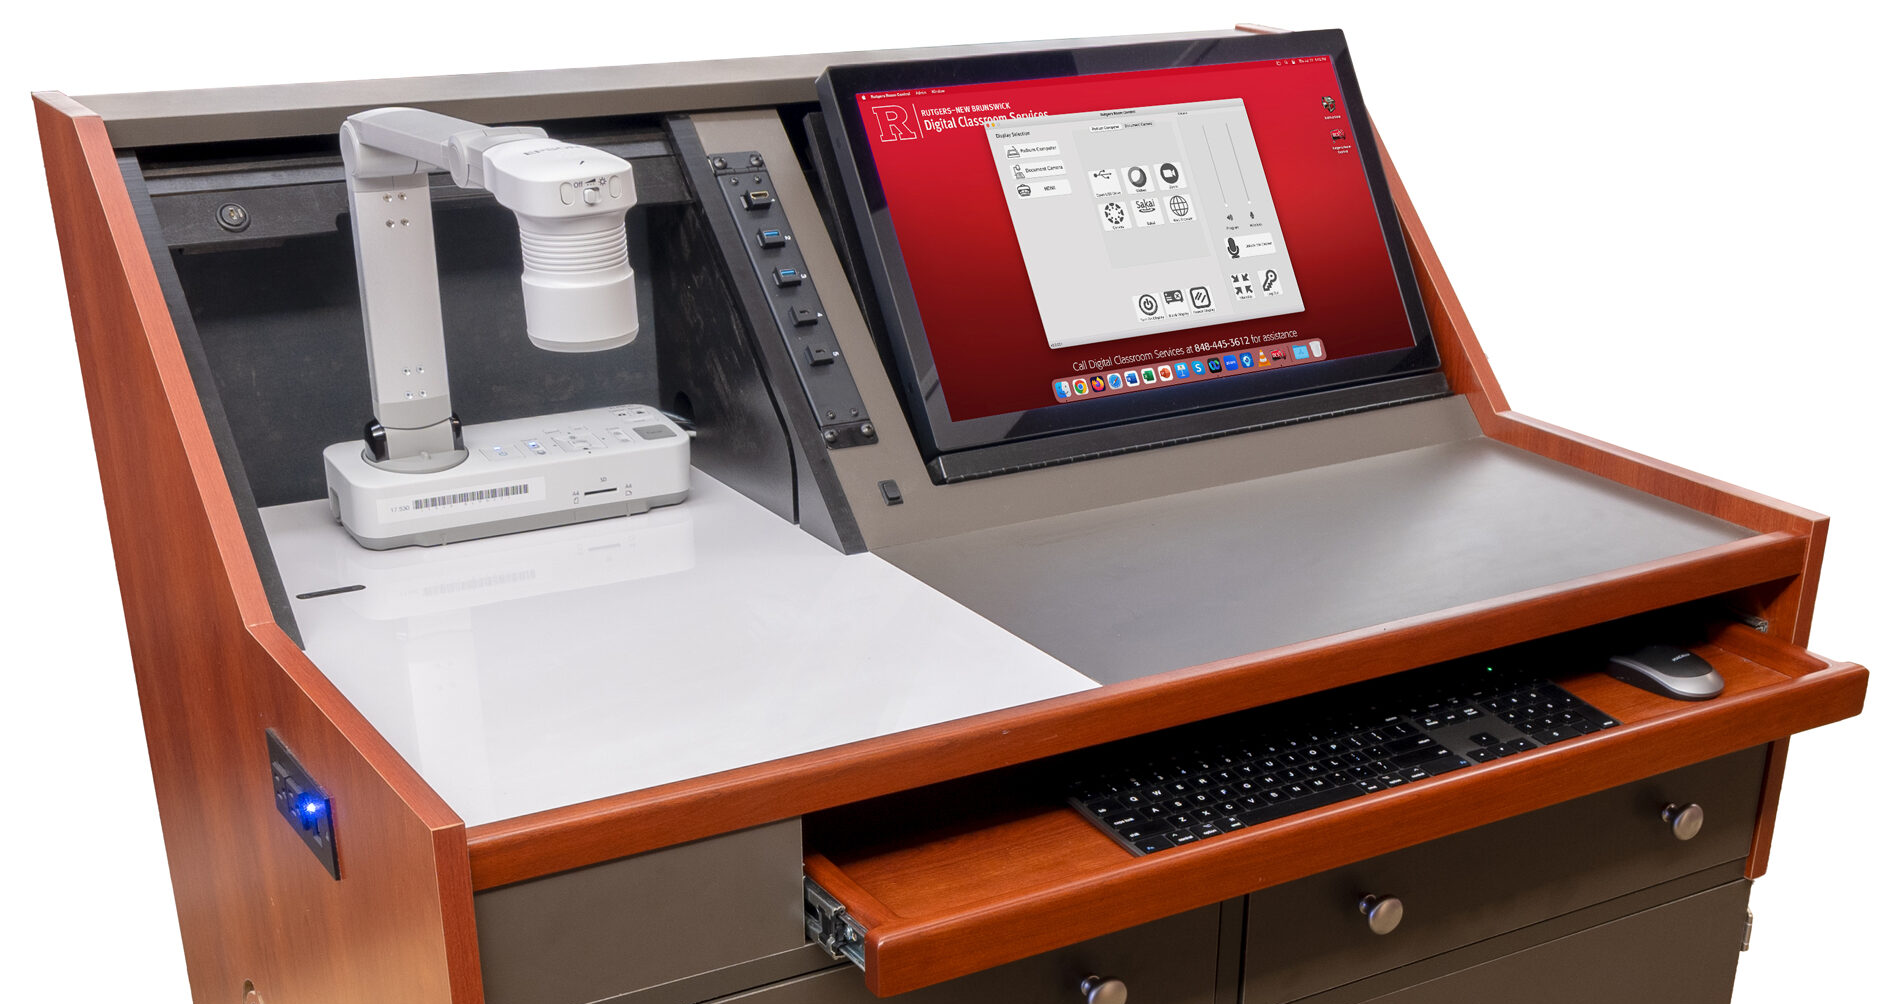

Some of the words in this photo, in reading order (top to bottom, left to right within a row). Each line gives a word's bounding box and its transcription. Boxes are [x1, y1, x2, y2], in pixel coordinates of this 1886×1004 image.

[972, 102, 1011, 112] BRUNSWICK
[872, 104, 917, 142] R
[924, 116, 957, 132] Digital
[1136, 199, 1155, 209] Sakai
[1072, 360, 1088, 372] Call
[1088, 357, 1112, 370] Digital
[1113, 352, 1154, 365] Classroom
[1154, 347, 1184, 359] Services
[1194, 336, 1250, 353] 848-445-3612
[1251, 334, 1261, 343] for
[1262, 330, 1298, 342] assistance
